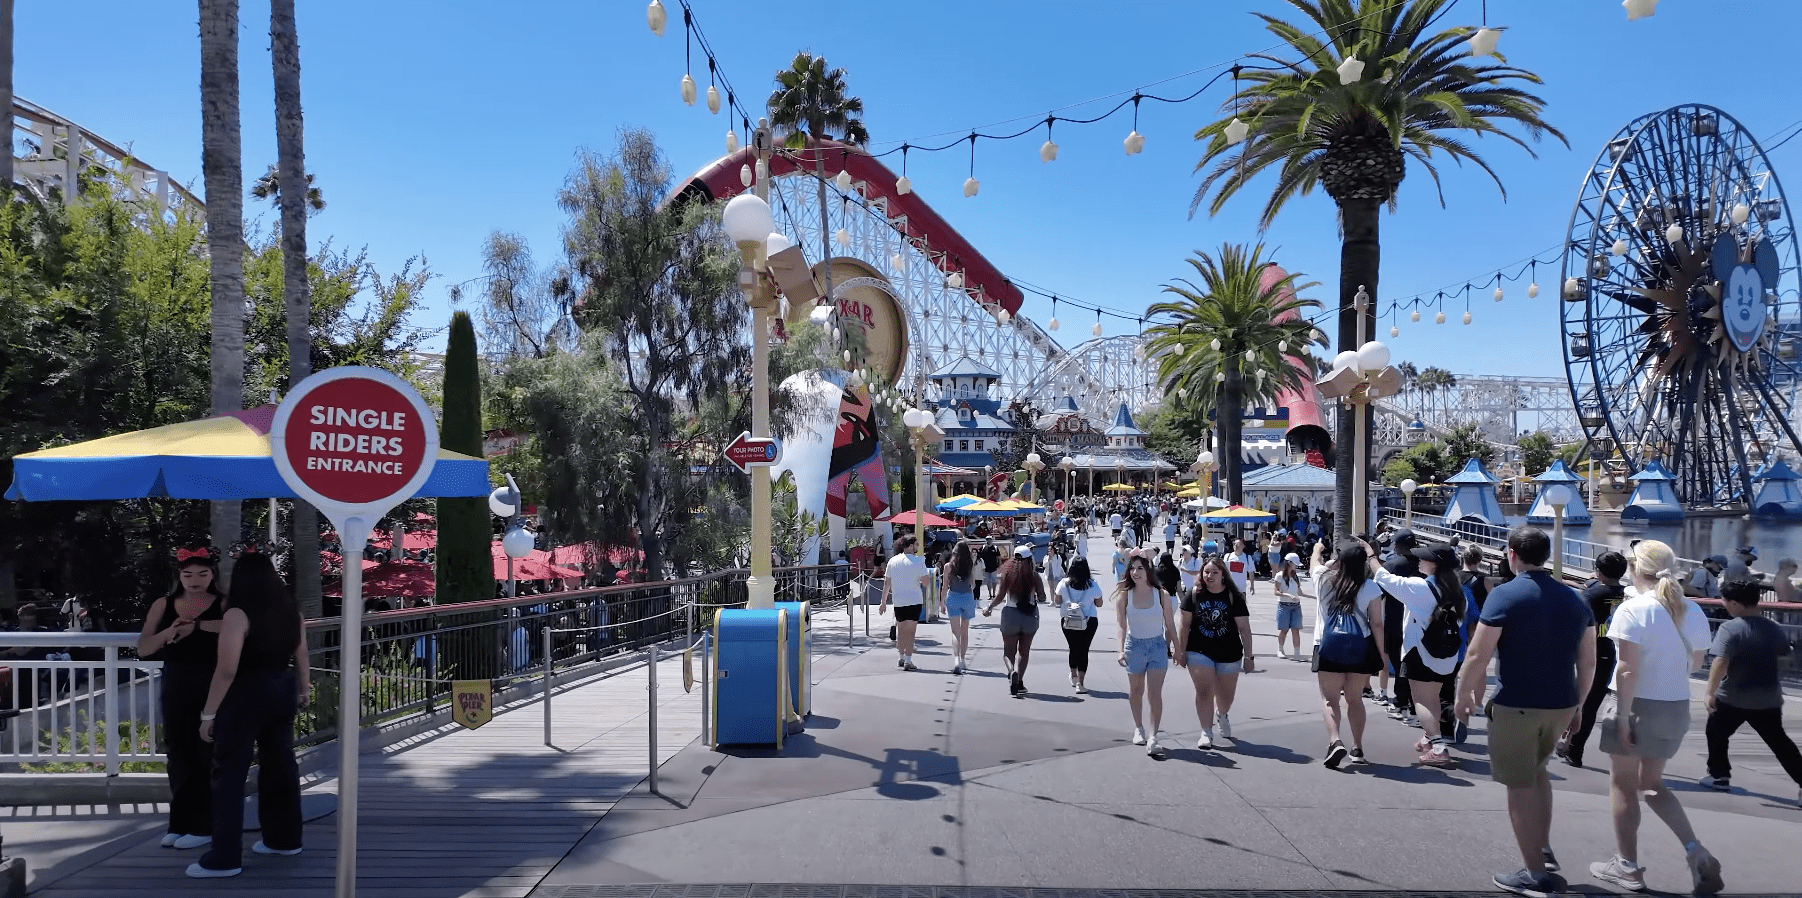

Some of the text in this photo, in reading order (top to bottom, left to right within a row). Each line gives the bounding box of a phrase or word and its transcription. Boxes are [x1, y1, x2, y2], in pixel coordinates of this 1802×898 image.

[310, 405, 406, 431] SINGLE
[309, 431, 403, 456] RIDERS
[306, 456, 403, 475] ENTRANCE
[458, 693, 486, 705] PIXAR
[461, 701, 484, 713] PIER
